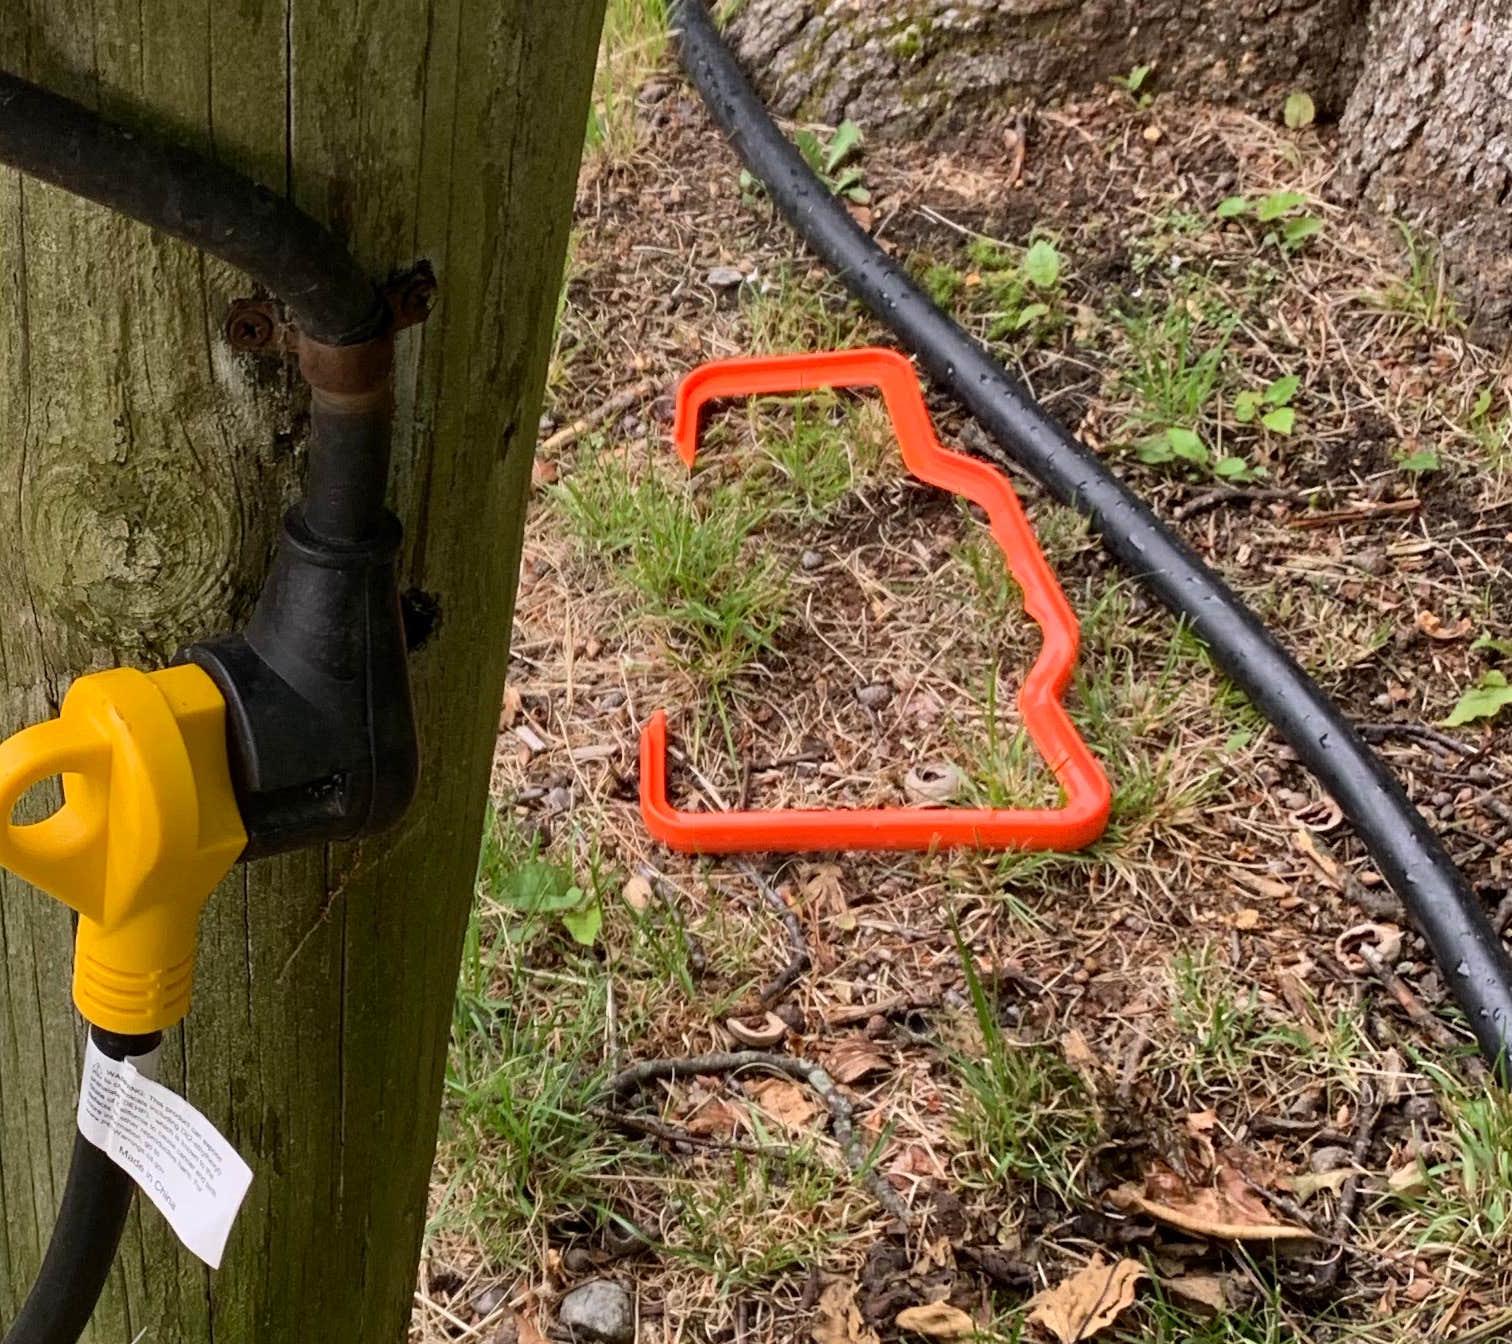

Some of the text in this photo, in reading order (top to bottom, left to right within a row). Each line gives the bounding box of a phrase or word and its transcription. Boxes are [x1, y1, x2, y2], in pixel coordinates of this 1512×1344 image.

[119, 1146, 144, 1173] Made
[146, 1170, 153, 1182] in
[154, 1179, 177, 1211] China
